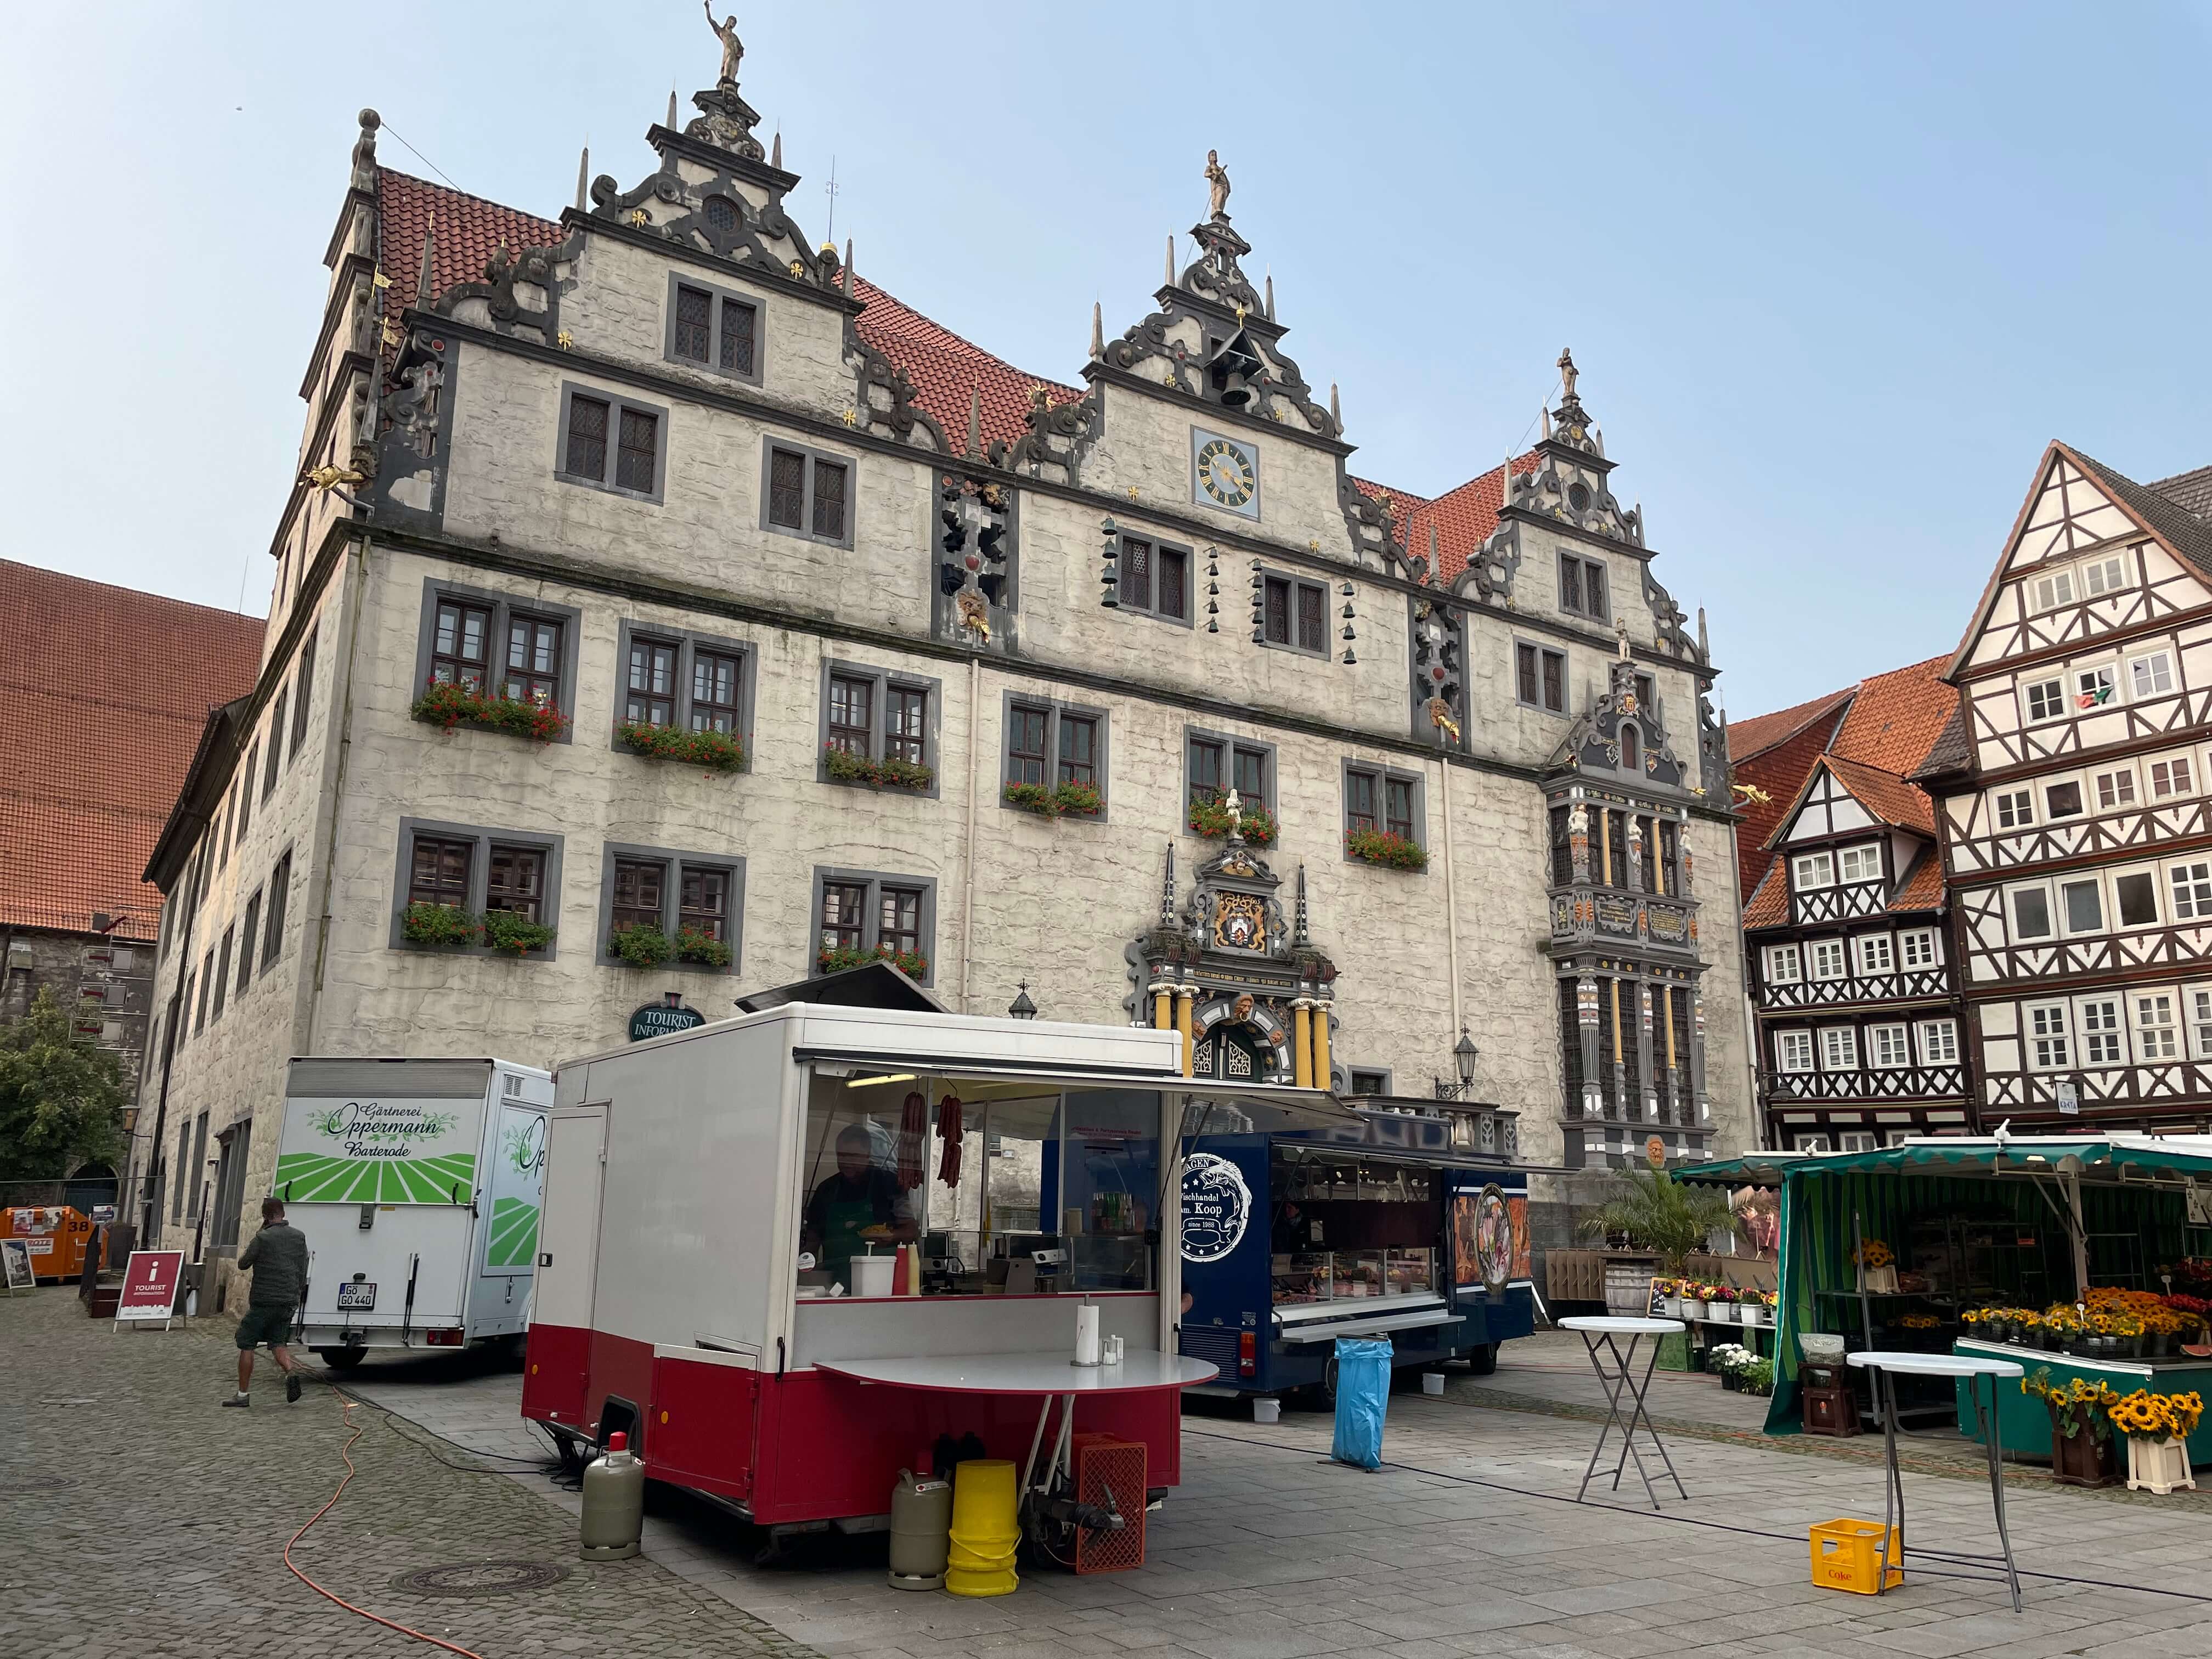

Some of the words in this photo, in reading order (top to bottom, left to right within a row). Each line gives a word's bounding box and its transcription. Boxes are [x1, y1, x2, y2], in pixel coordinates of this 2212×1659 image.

[645, 1011, 696, 1031] TOURIST
[360, 1103, 421, 1120] Gärtnerei
[328, 1102, 440, 1139] Oppermann
[345, 1142, 411, 1157] Barterode
[1185, 1159, 1210, 1172] AGEN
[1194, 1203, 1222, 1217] Koop
[68, 1221, 89, 1232] 38
[346, 1285, 358, 1295] GÖ
[341, 1295, 353, 1305] GO
[354, 1295, 371, 1305] 440
[1829, 1570, 1852, 1581] Coke
